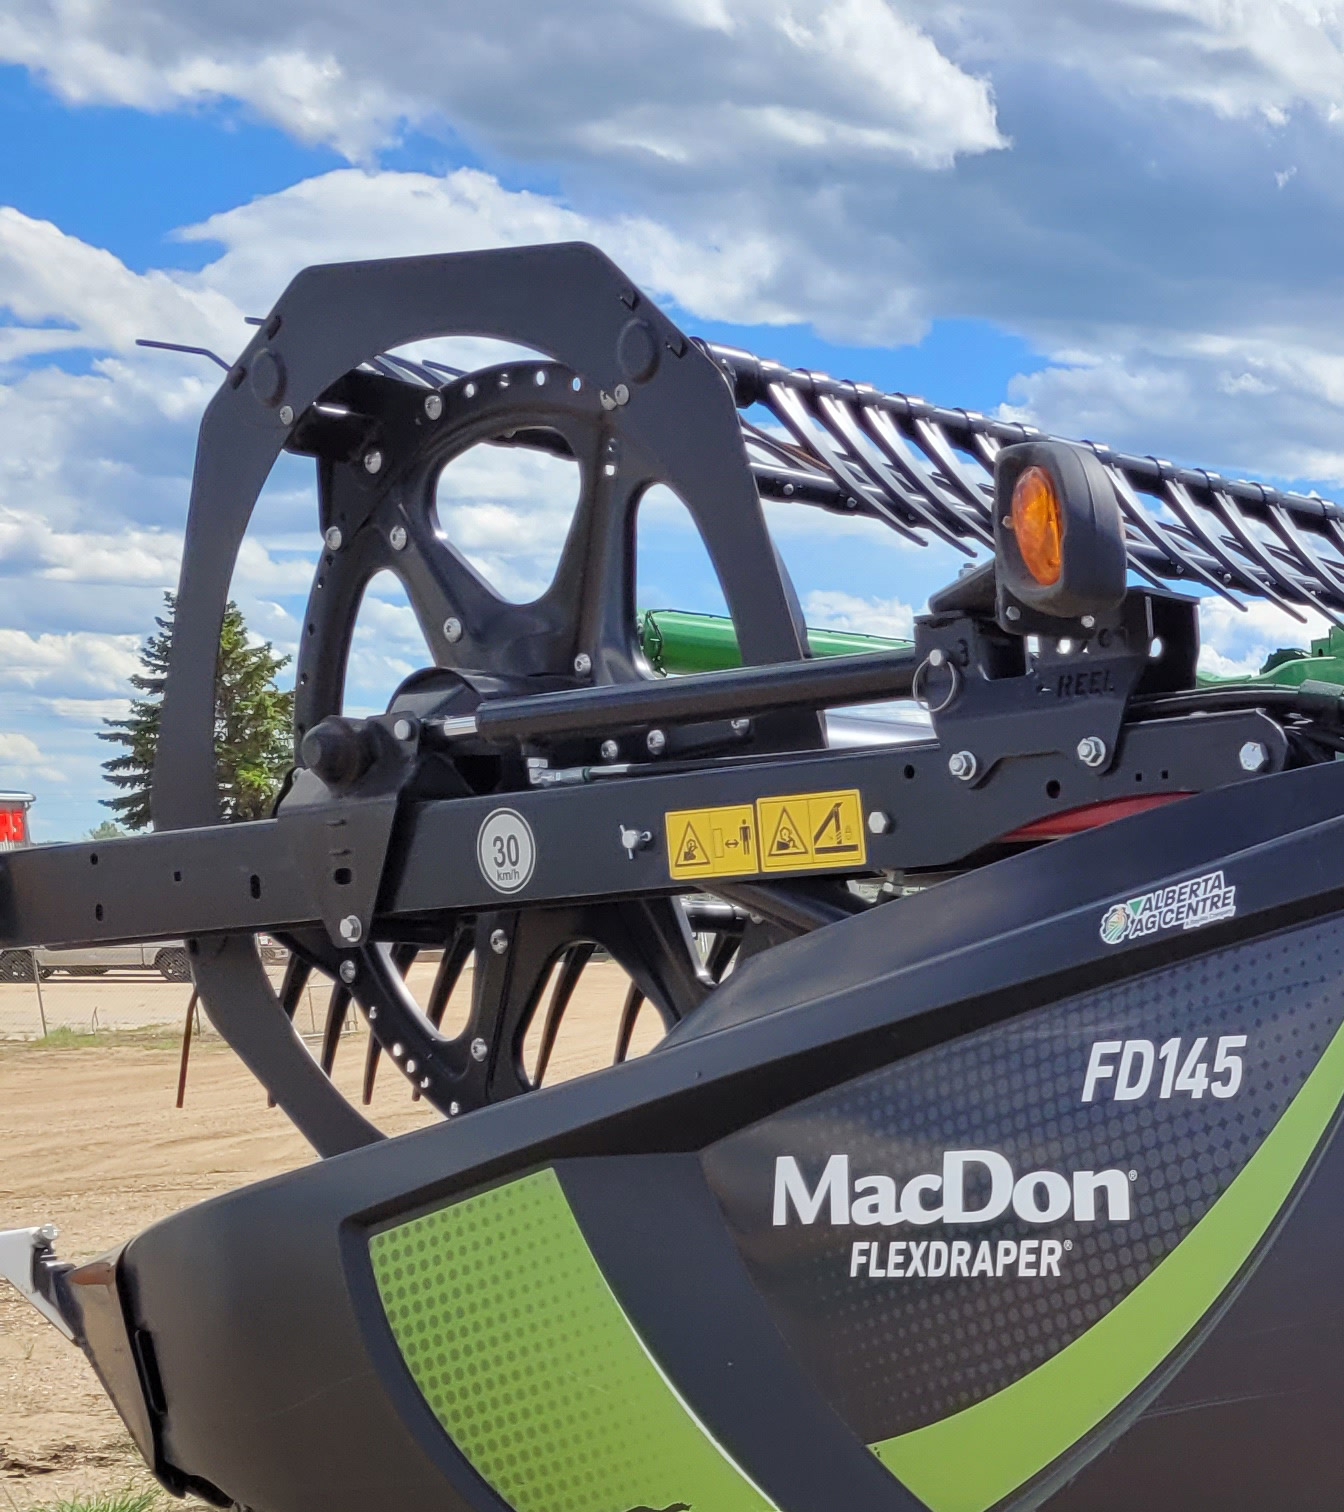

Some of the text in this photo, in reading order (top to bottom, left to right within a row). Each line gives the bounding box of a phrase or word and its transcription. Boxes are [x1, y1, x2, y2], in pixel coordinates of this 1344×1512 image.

[1057, 670, 1115, 698] REEL
[492, 834, 520, 868] 30
[496, 869, 520, 881] km/h
[1140, 873, 1222, 915] ALBERTA
[1131, 914, 1157, 936] AG
[1162, 888, 1234, 926] CENTRE
[1081, 1035, 1247, 1102] FD145
[772, 1150, 1131, 1225] MacDon
[849, 1240, 1062, 1278] FLEXDRAPER
